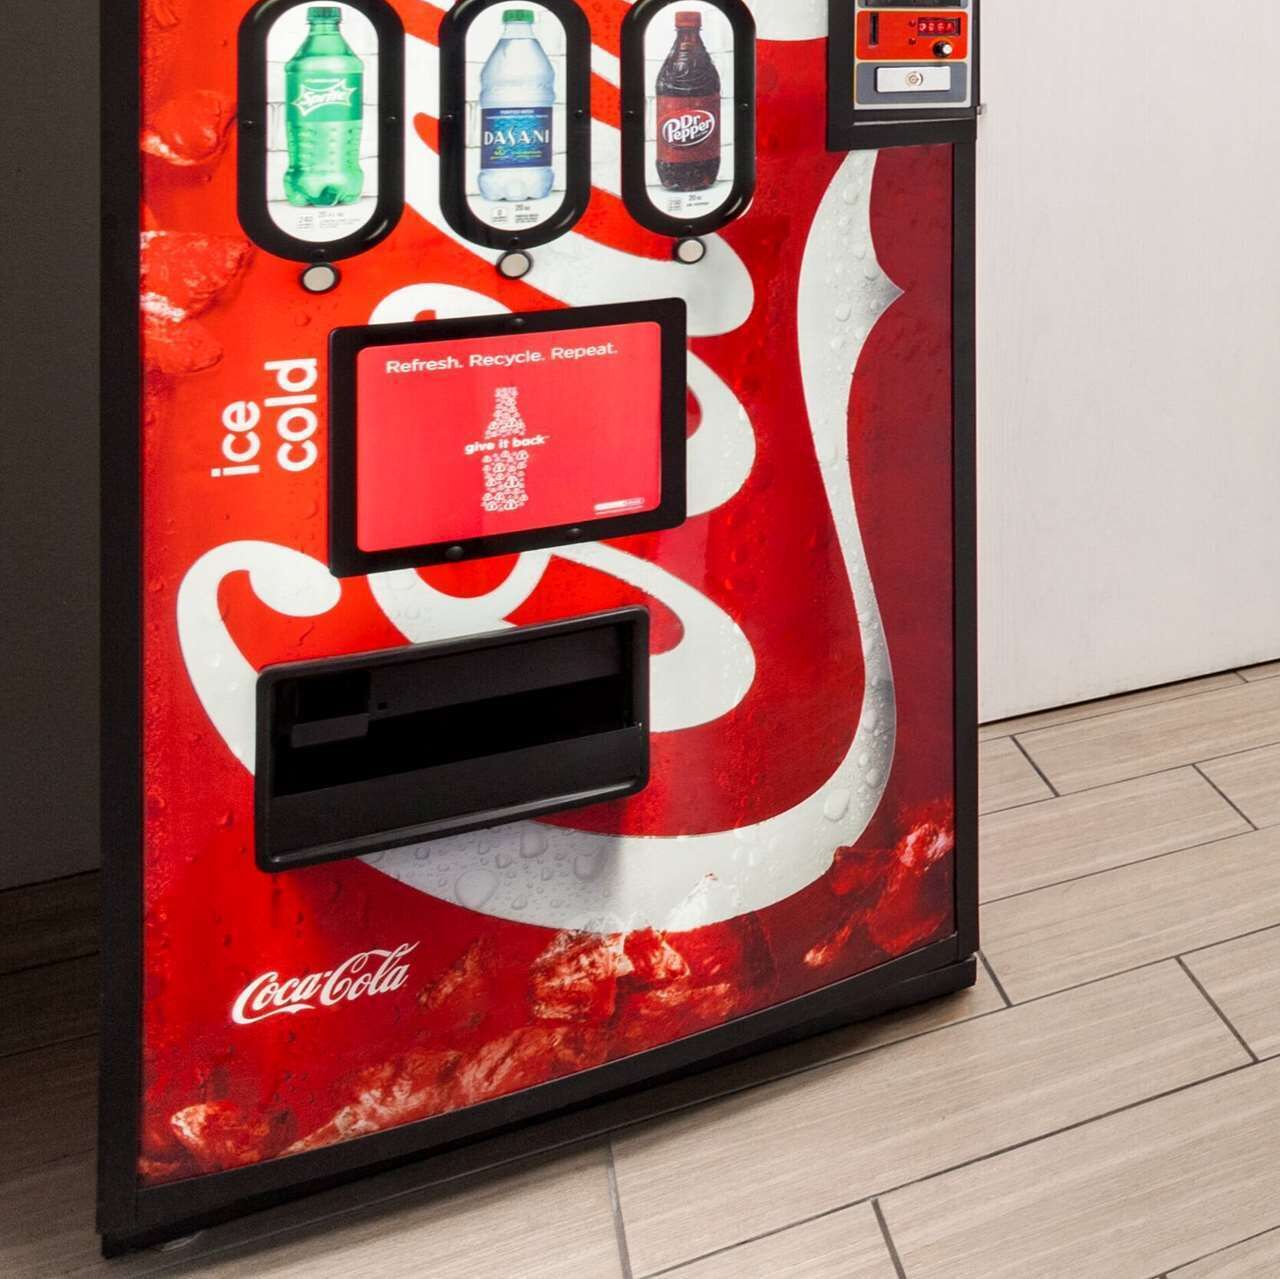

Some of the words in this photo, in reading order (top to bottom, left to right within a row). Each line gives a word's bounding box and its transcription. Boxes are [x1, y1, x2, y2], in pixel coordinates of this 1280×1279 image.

[662, 118, 712, 143] Pepper
[680, 114, 701, 129] Dr
[484, 126, 549, 147] DASANI
[385, 356, 463, 374] Refresh.
[469, 349, 545, 369] Recycle.
[551, 341, 618, 361] Repeat.
[263, 357, 318, 472] cold
[211, 400, 260, 477] ice
[464, 441, 495, 455] give
[499, 438, 509, 449] it
[232, 941, 420, 1025] Coca-Cola
